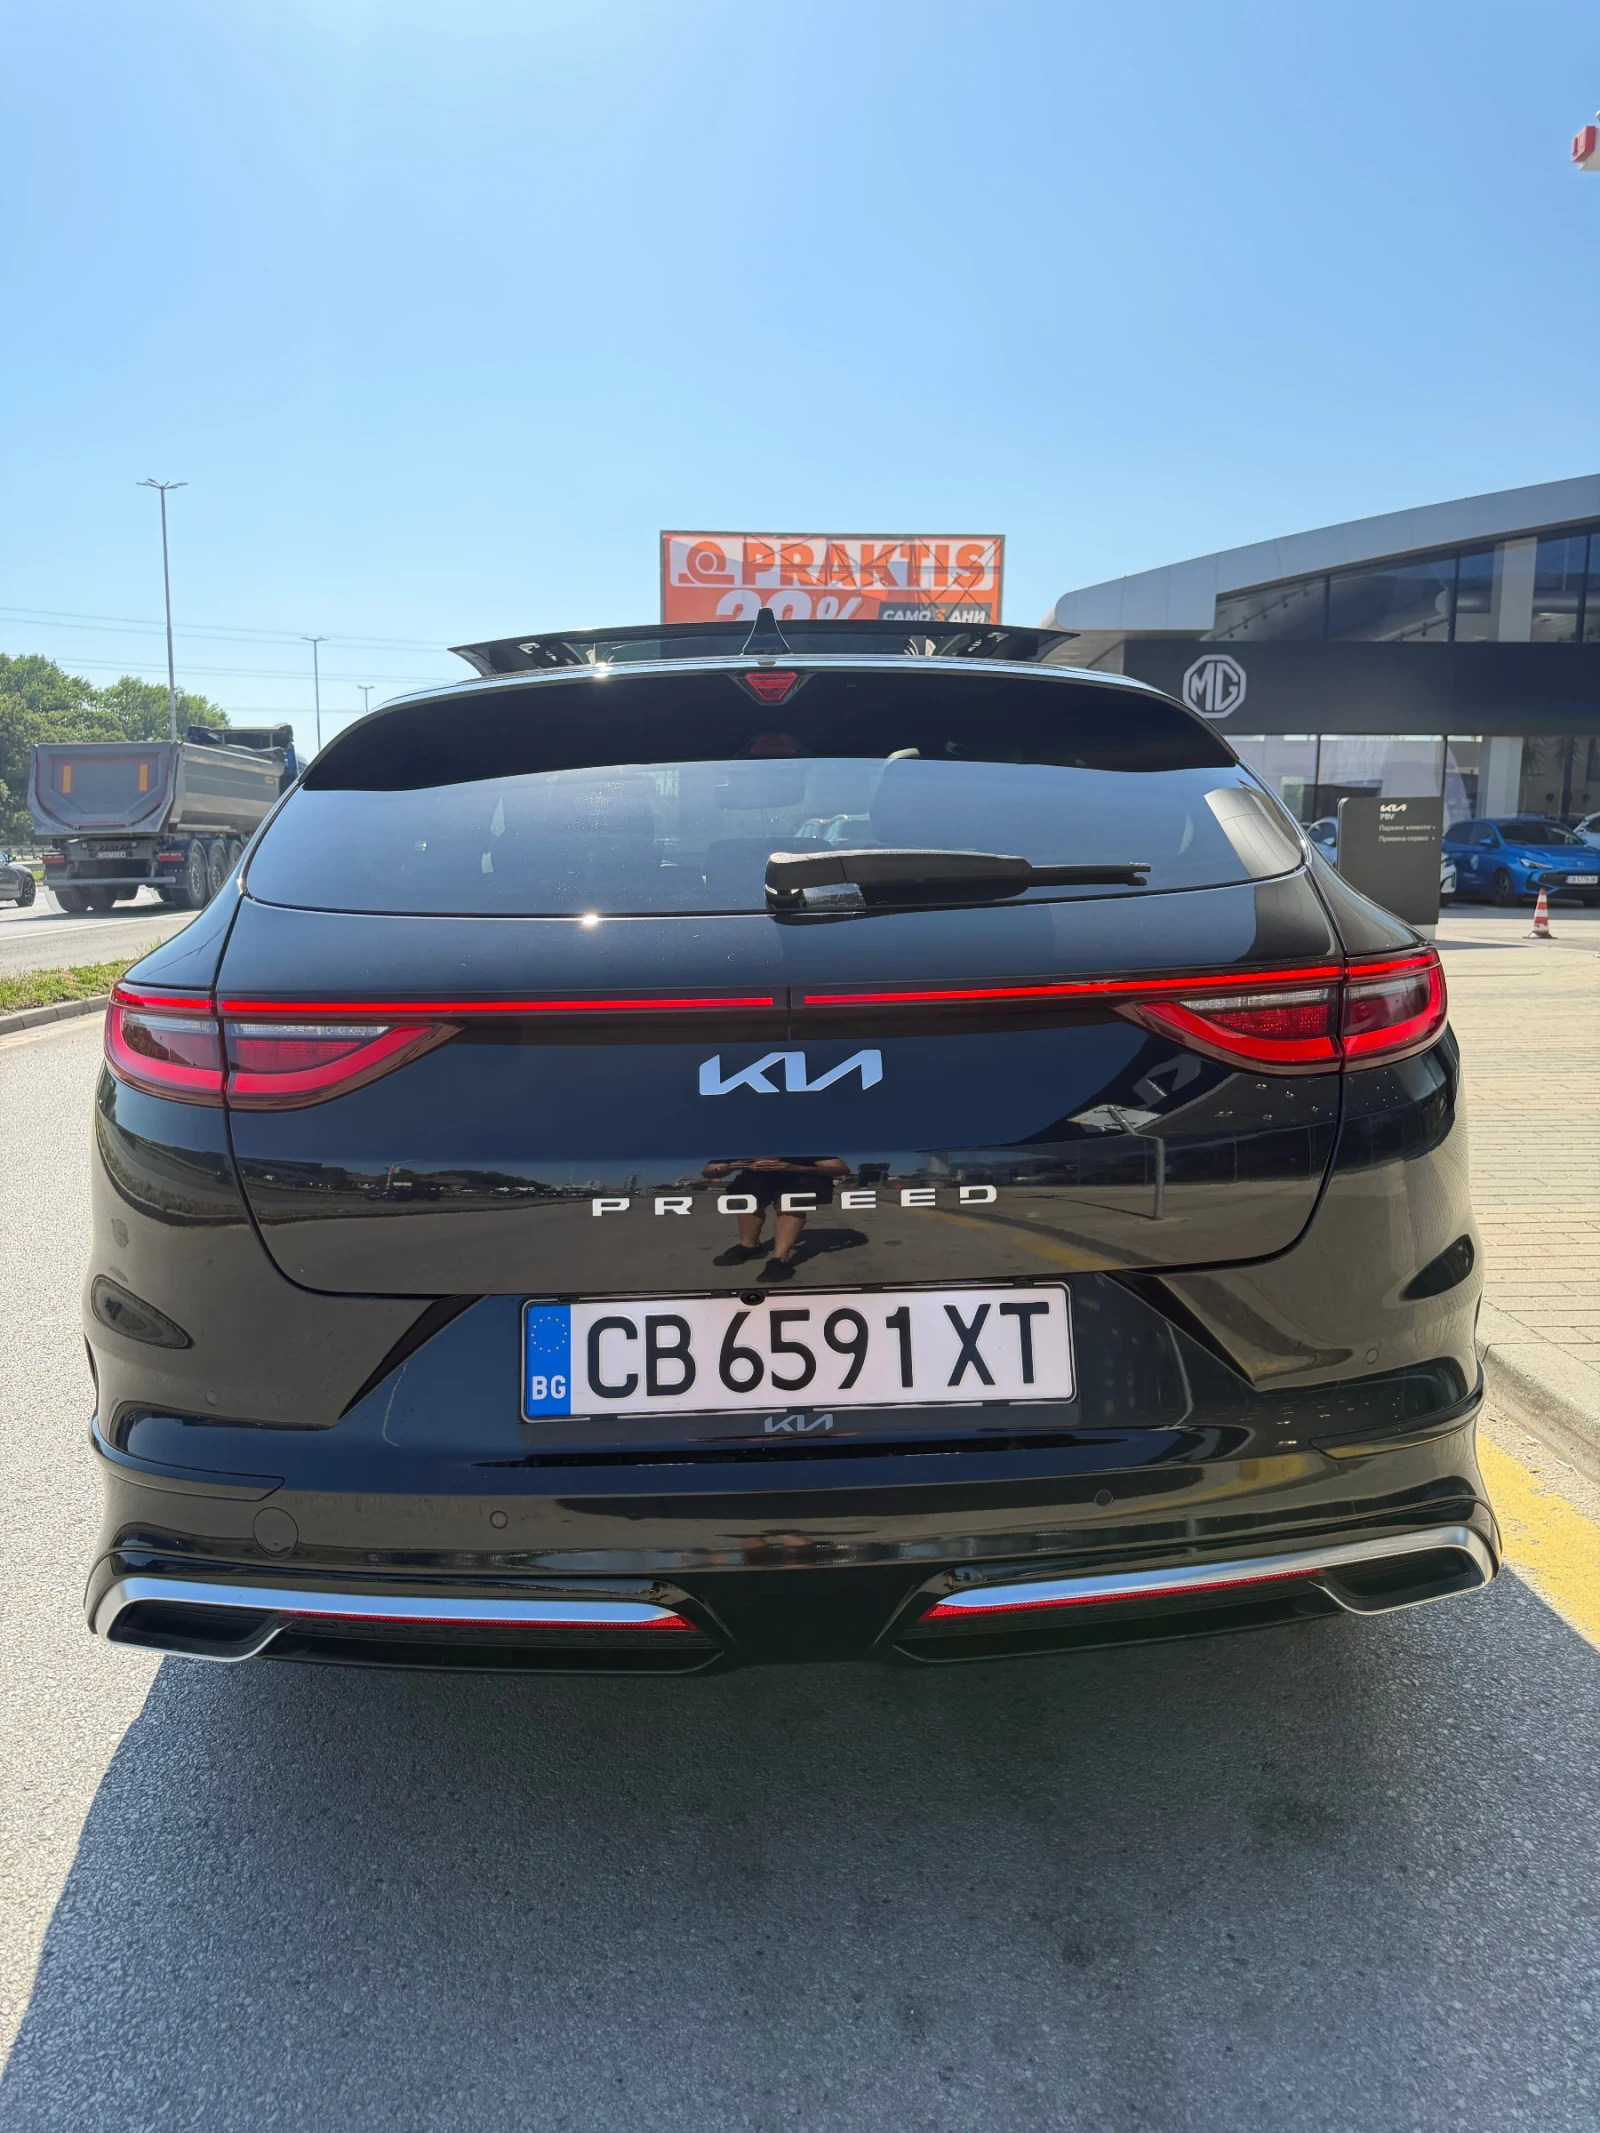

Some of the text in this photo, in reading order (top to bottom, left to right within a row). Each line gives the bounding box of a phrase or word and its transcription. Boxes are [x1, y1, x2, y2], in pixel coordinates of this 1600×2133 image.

[742, 541, 986, 588] PRAKTIS
[1190, 662, 1240, 711] MG
[700, 1049, 883, 1096] KIA
[592, 1185, 998, 1217] PROCEED
[587, 1301, 1050, 1398] CB 6591 XT
[532, 1375, 566, 1400] BG
[764, 1413, 834, 1433] KIA
